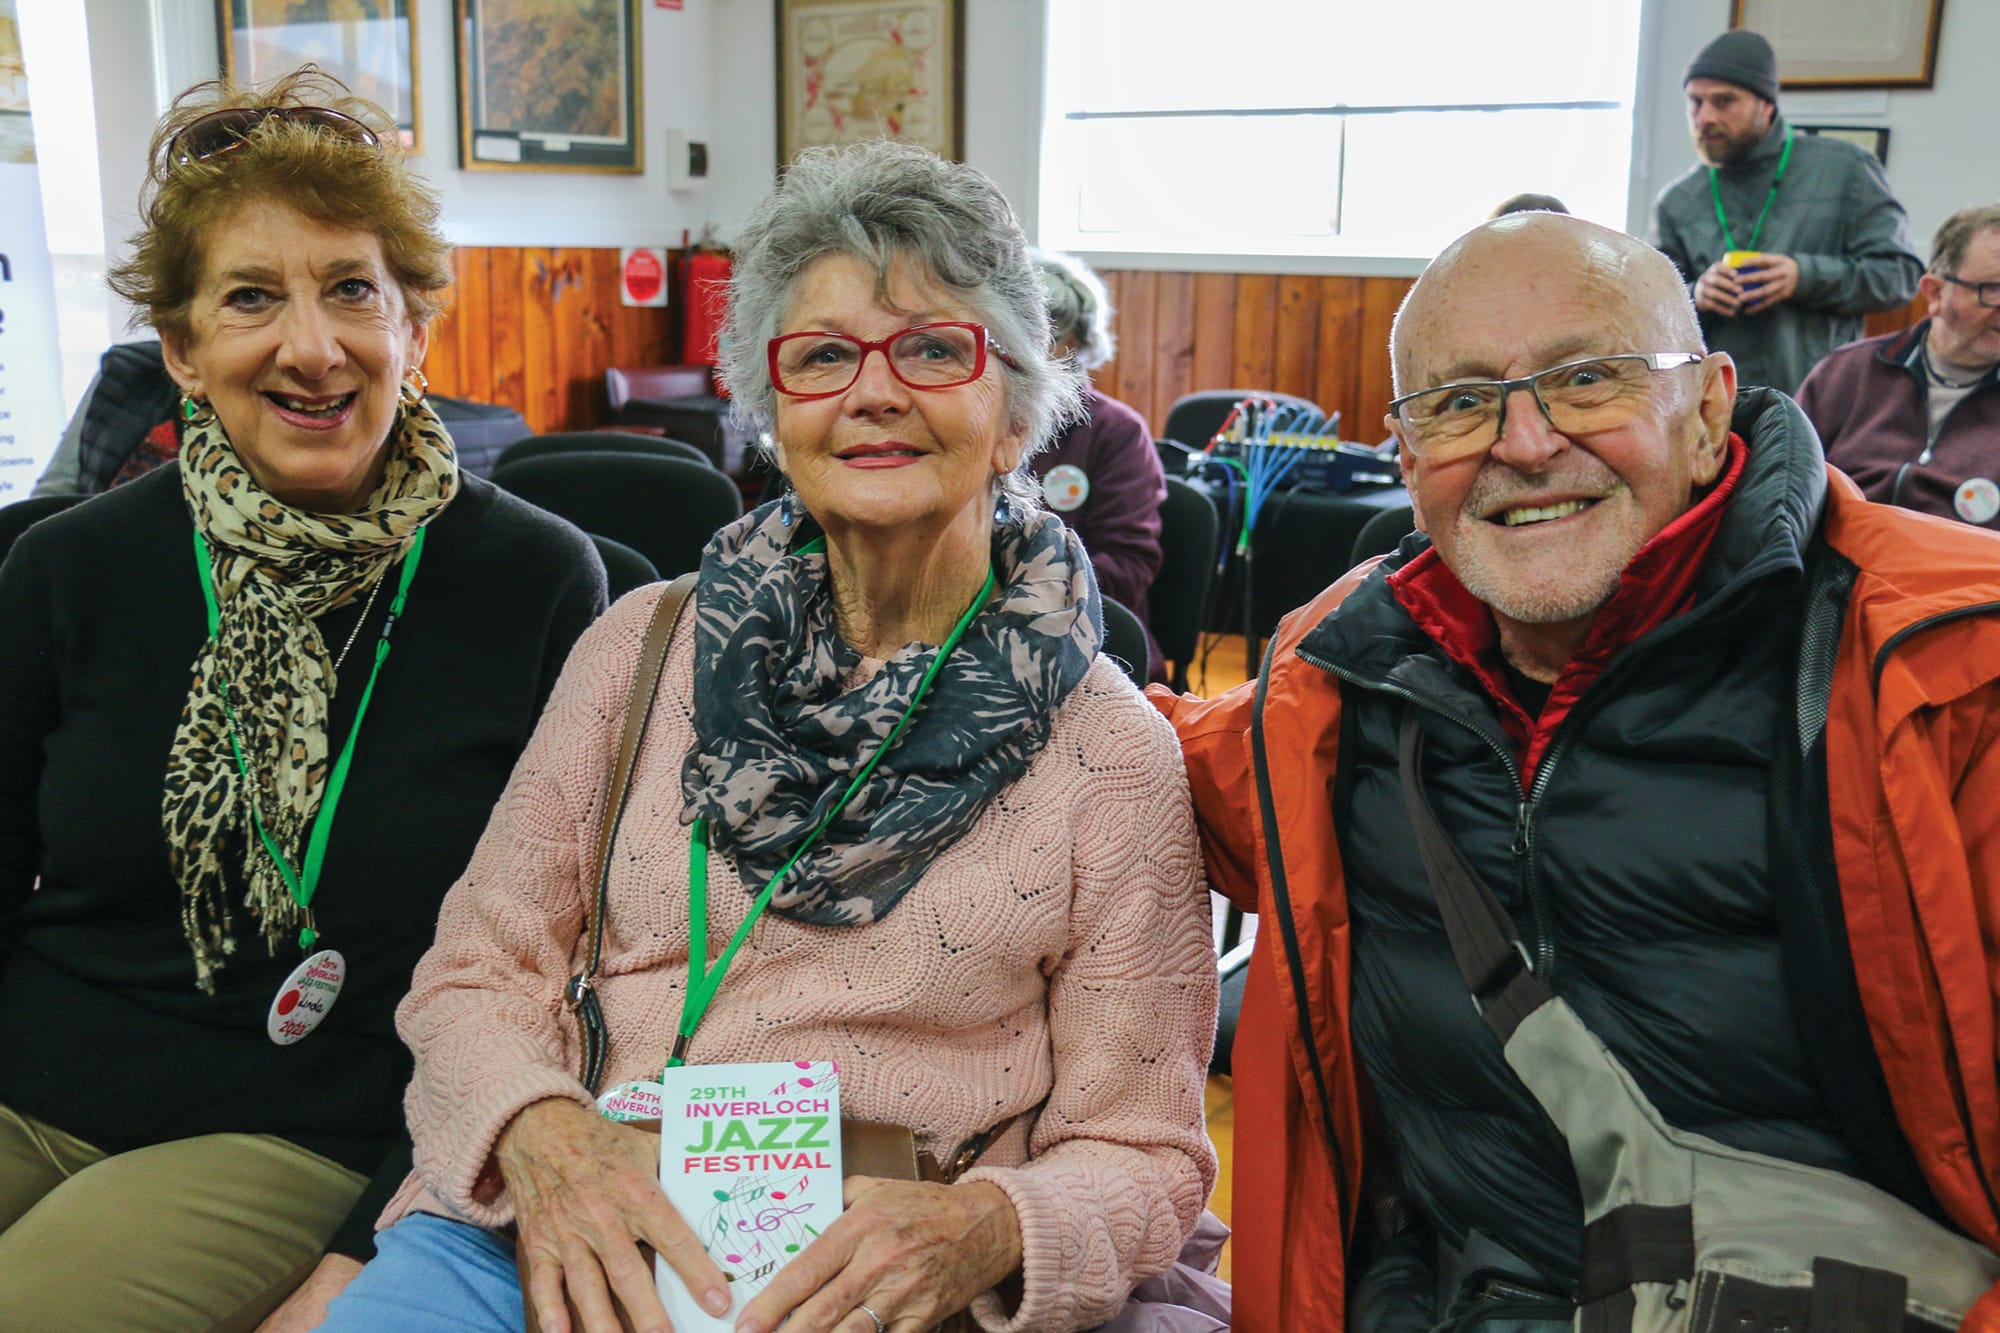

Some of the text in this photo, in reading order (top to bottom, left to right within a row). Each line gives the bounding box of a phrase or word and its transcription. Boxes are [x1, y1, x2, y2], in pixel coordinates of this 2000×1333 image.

[630, 1090, 661, 1104] 29TH
[690, 1086, 746, 1100] 29TH
[685, 1099, 829, 1118] INVERLOCH
[684, 1116, 830, 1153] JAZZ
[683, 1152, 832, 1174] FESTIVAL
